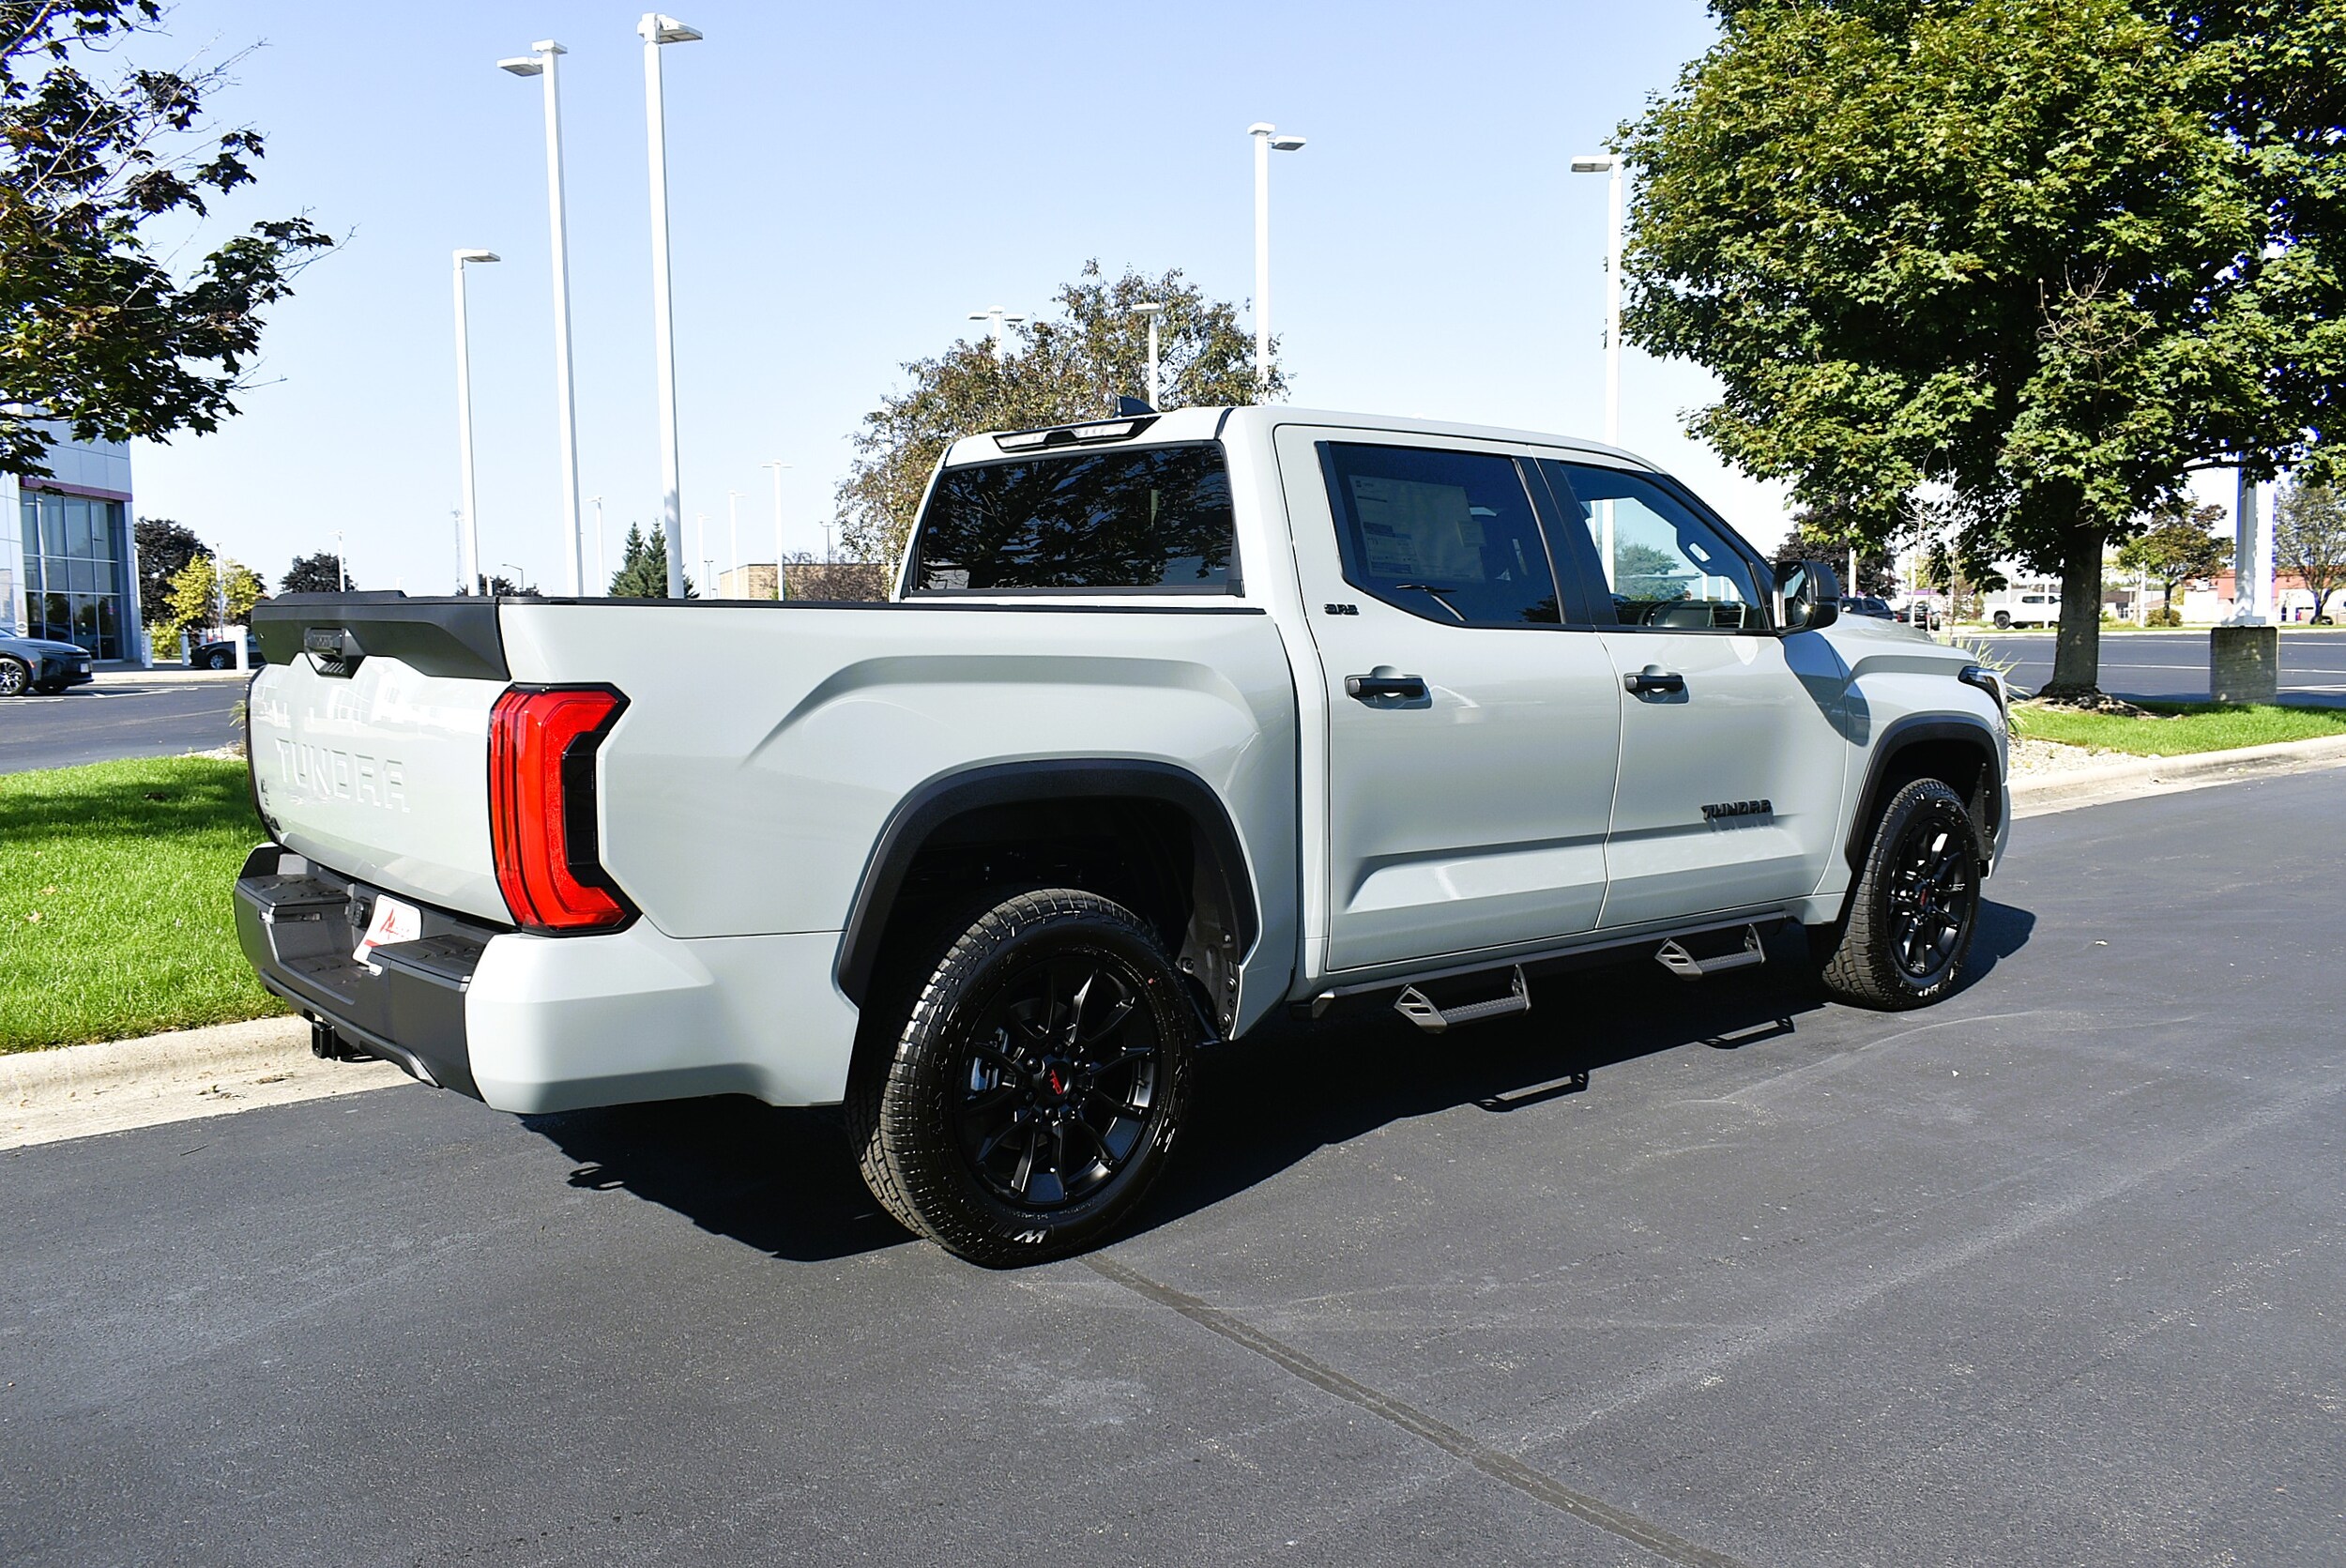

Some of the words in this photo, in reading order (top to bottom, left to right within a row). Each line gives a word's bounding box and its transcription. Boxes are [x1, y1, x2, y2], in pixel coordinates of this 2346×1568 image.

[274, 737, 412, 814] TUNDRA
[1700, 799, 1773, 821] TUNDRA
[1049, 1069, 1063, 1095] TRD
